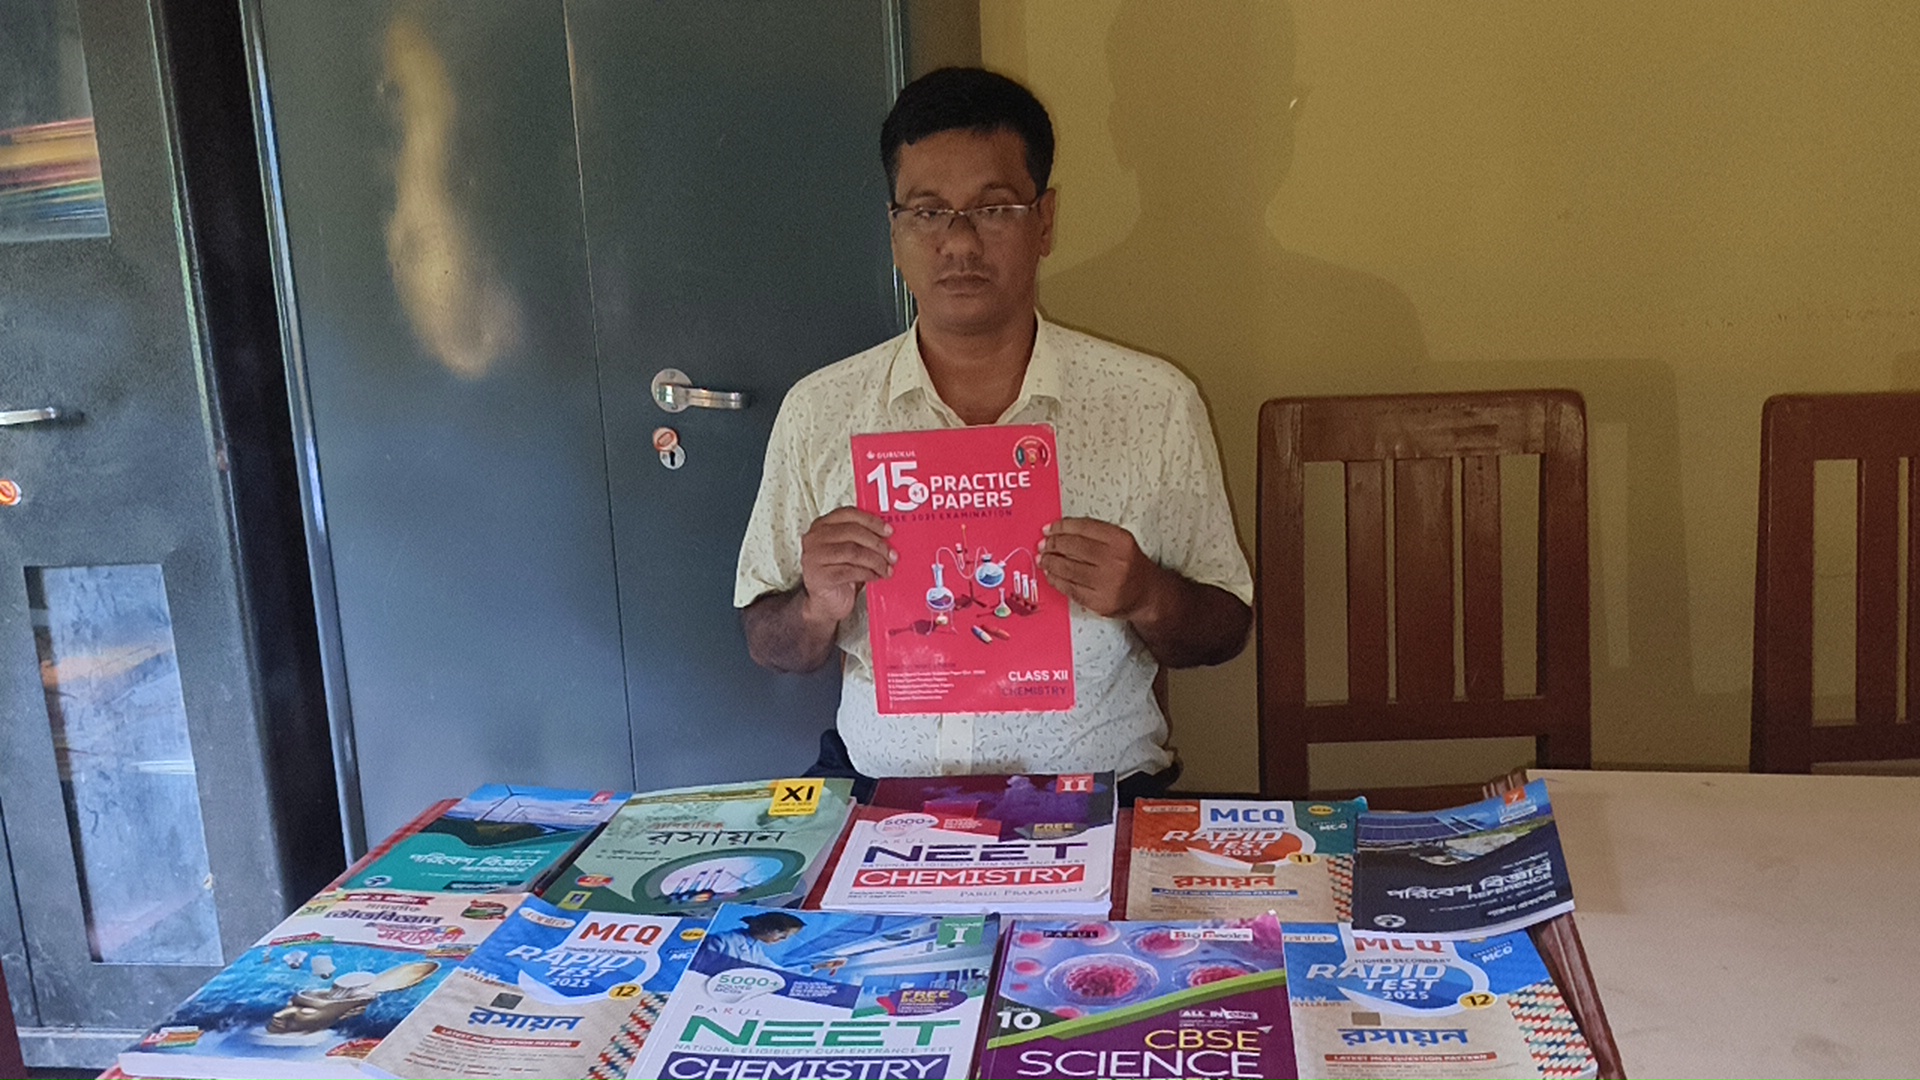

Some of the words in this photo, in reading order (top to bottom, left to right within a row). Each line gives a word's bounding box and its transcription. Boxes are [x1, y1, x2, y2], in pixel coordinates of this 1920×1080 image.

[867, 461, 921, 512] 15
[930, 471, 1031, 492] PRACTICE
[932, 491, 1013, 510] PAPERS
[939, 510, 1012, 520] EXAMINATION
[1008, 670, 1050, 682] CLASS
[1052, 669, 1069, 680] XII
[1001, 685, 1067, 697] CHEMISTRY
[781, 786, 814, 801] XI
[1210, 808, 1286, 824] MCQ
[647, 829, 786, 846] রসায়ন
[1161, 830, 1284, 841] RAPID
[864, 842, 1088, 863] NEET
[1209, 841, 1276, 850] TEST
[860, 867, 1080, 886] CHEMISTRY
[1172, 875, 1276, 888] রসায়ন
[1386, 884, 1473, 899] পরিবেশ
[1479, 861, 1552, 890] বিজ্ঞান
[1468, 874, 1552, 900] REFERENCE
[579, 922, 662, 946] MCQ
[505, 944, 640, 968] RAPID
[1481, 945, 1513, 963] MCQ
[545, 966, 618, 978] TEST
[1306, 963, 1446, 979] RAPID
[549, 977, 592, 988] 2025
[719, 975, 779, 987] 5000+
[1363, 978, 1440, 990] TEST
[615, 985, 637, 997] 12
[1382, 991, 1429, 1000] 2025
[1466, 994, 1490, 1006] 12
[694, 1004, 762, 1016] PARUL
[1181, 1010, 1205, 1018] ALL
[468, 1006, 585, 1032] রসায়ন
[997, 1011, 1041, 1030] 10
[679, 1015, 961, 1046] NEET
[1337, 1028, 1468, 1047] রসায়ন
[1144, 1028, 1262, 1051] CBSE
[674, 1043, 731, 1053] NATIONAL
[740, 1047, 810, 1055] ELIGIBILITY
[815, 1047, 846, 1055] CUM
[850, 1047, 916, 1055] ENTRANCE
[668, 1057, 942, 1080] CHEMISTRY
[1016, 1050, 1264, 1079] SCIENCE
